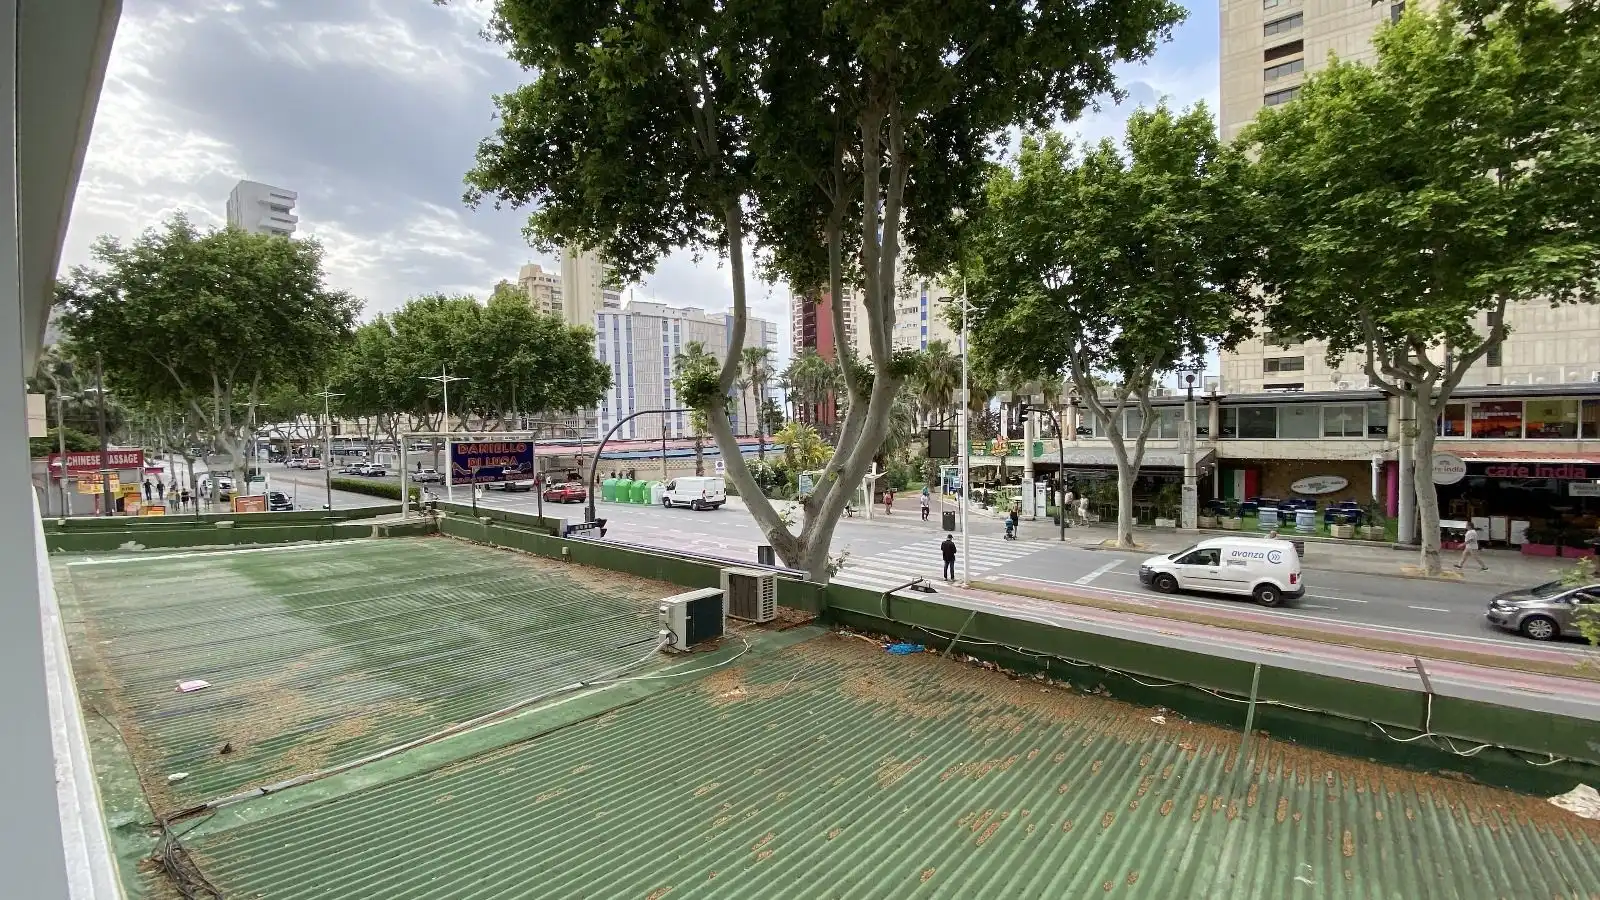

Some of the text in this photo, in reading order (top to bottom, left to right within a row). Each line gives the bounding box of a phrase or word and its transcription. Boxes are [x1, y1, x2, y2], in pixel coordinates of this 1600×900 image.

[457, 443, 527, 455] DANIELLO
[67, 453, 139, 467] CHINESE ASSAGE
[467, 456, 519, 468] DI LUCA
[1486, 463, 1588, 479] cafe india
[1231, 550, 1265, 559] avanza
